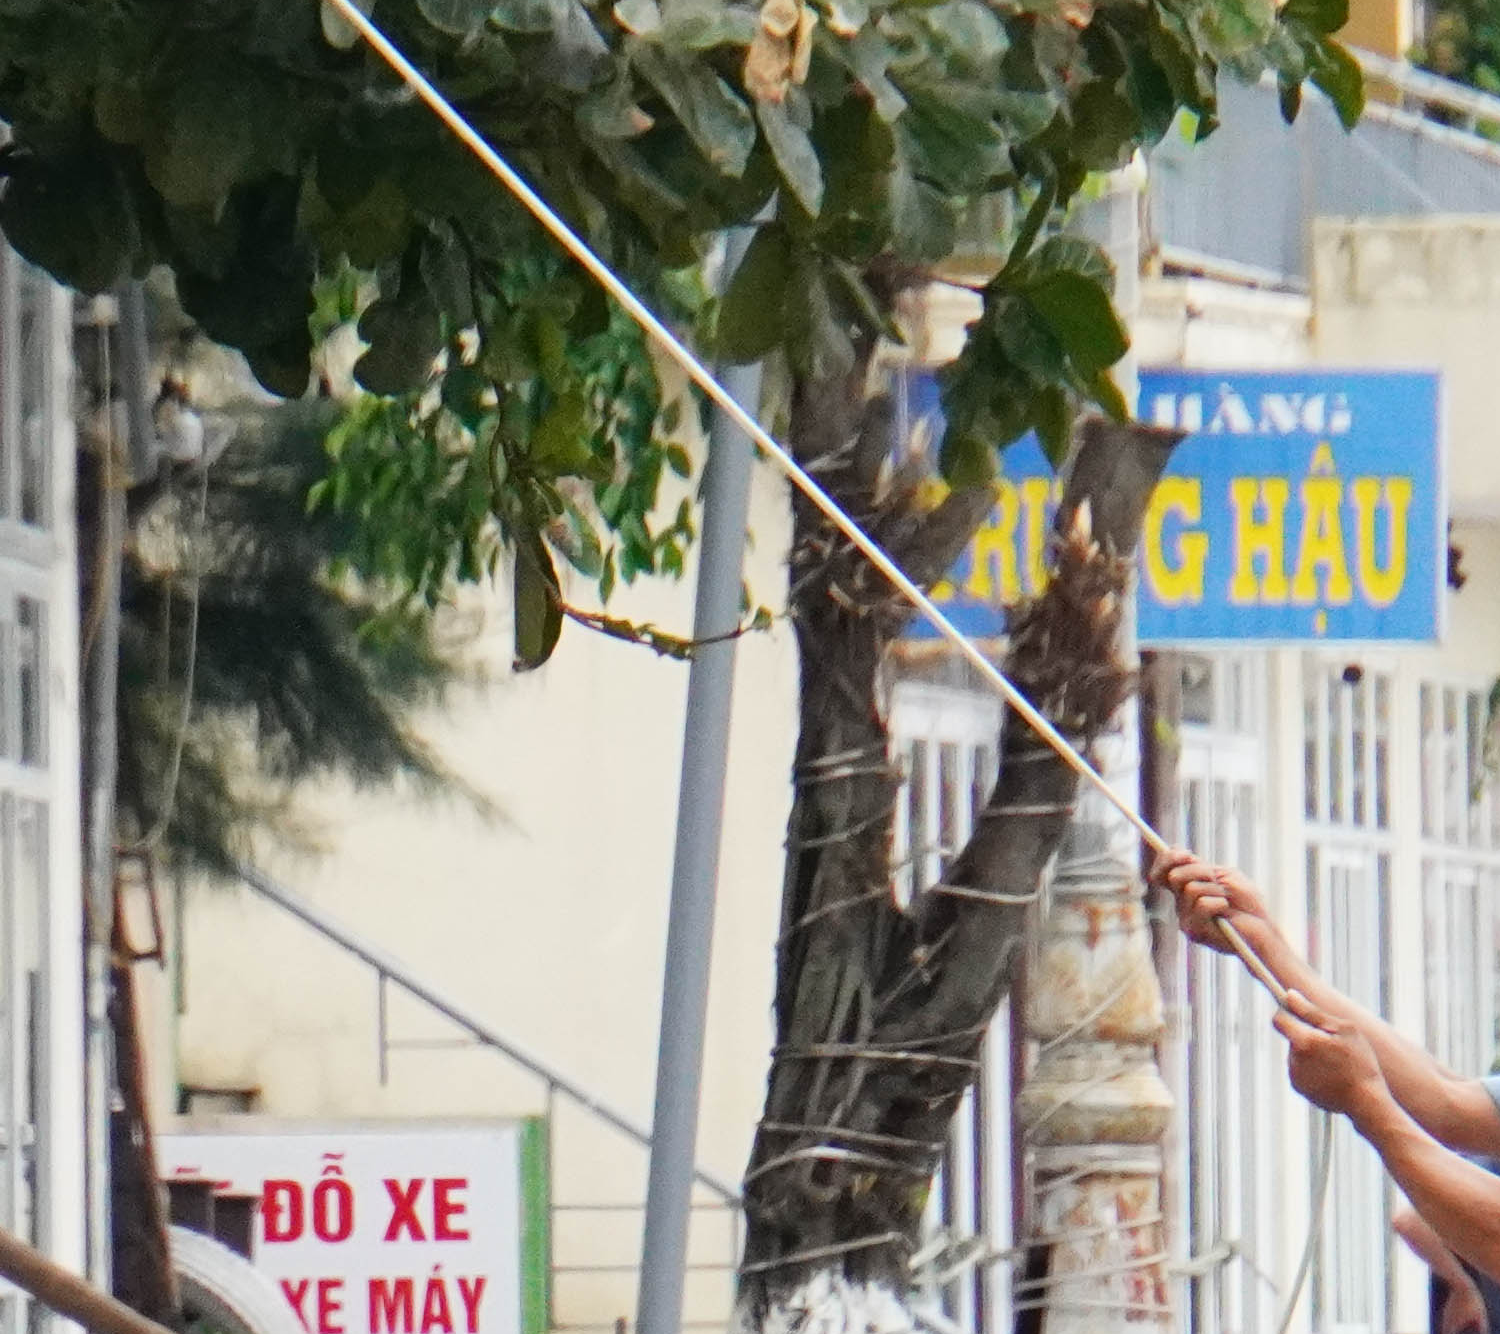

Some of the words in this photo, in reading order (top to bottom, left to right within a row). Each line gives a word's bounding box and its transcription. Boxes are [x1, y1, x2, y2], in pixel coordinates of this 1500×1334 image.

[1152, 383, 1354, 435] HÀNG
[1228, 442, 1414, 634] HẬU
[261, 1152, 355, 1244] ĐỖ
[383, 1177, 470, 1243] XE
